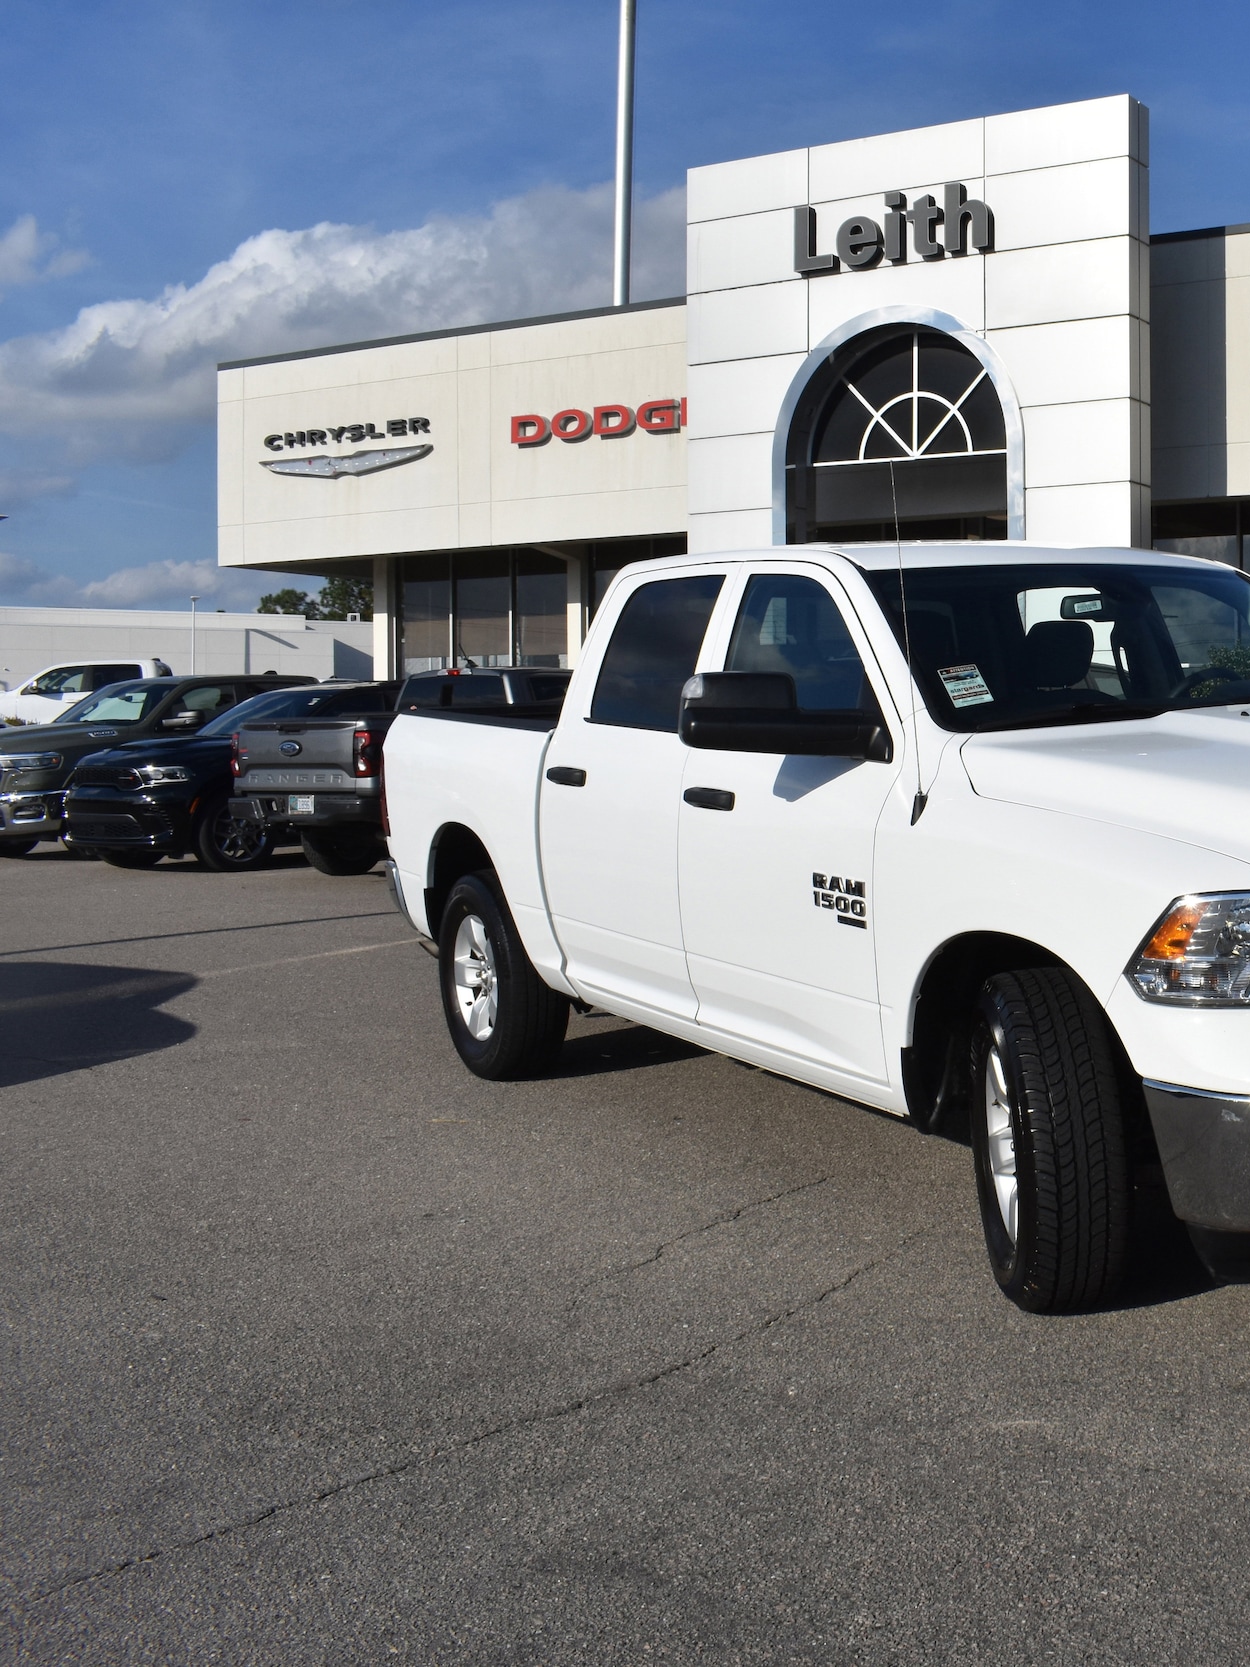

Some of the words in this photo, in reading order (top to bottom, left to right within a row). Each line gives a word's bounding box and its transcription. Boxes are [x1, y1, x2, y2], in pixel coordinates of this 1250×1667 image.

[793, 181, 996, 279] Leith
[263, 416, 432, 452] CHRYSLER
[510, 396, 688, 449] DODG
[247, 773, 344, 784] RANGER
[812, 871, 866, 899] RAM
[812, 890, 867, 918] 1500
